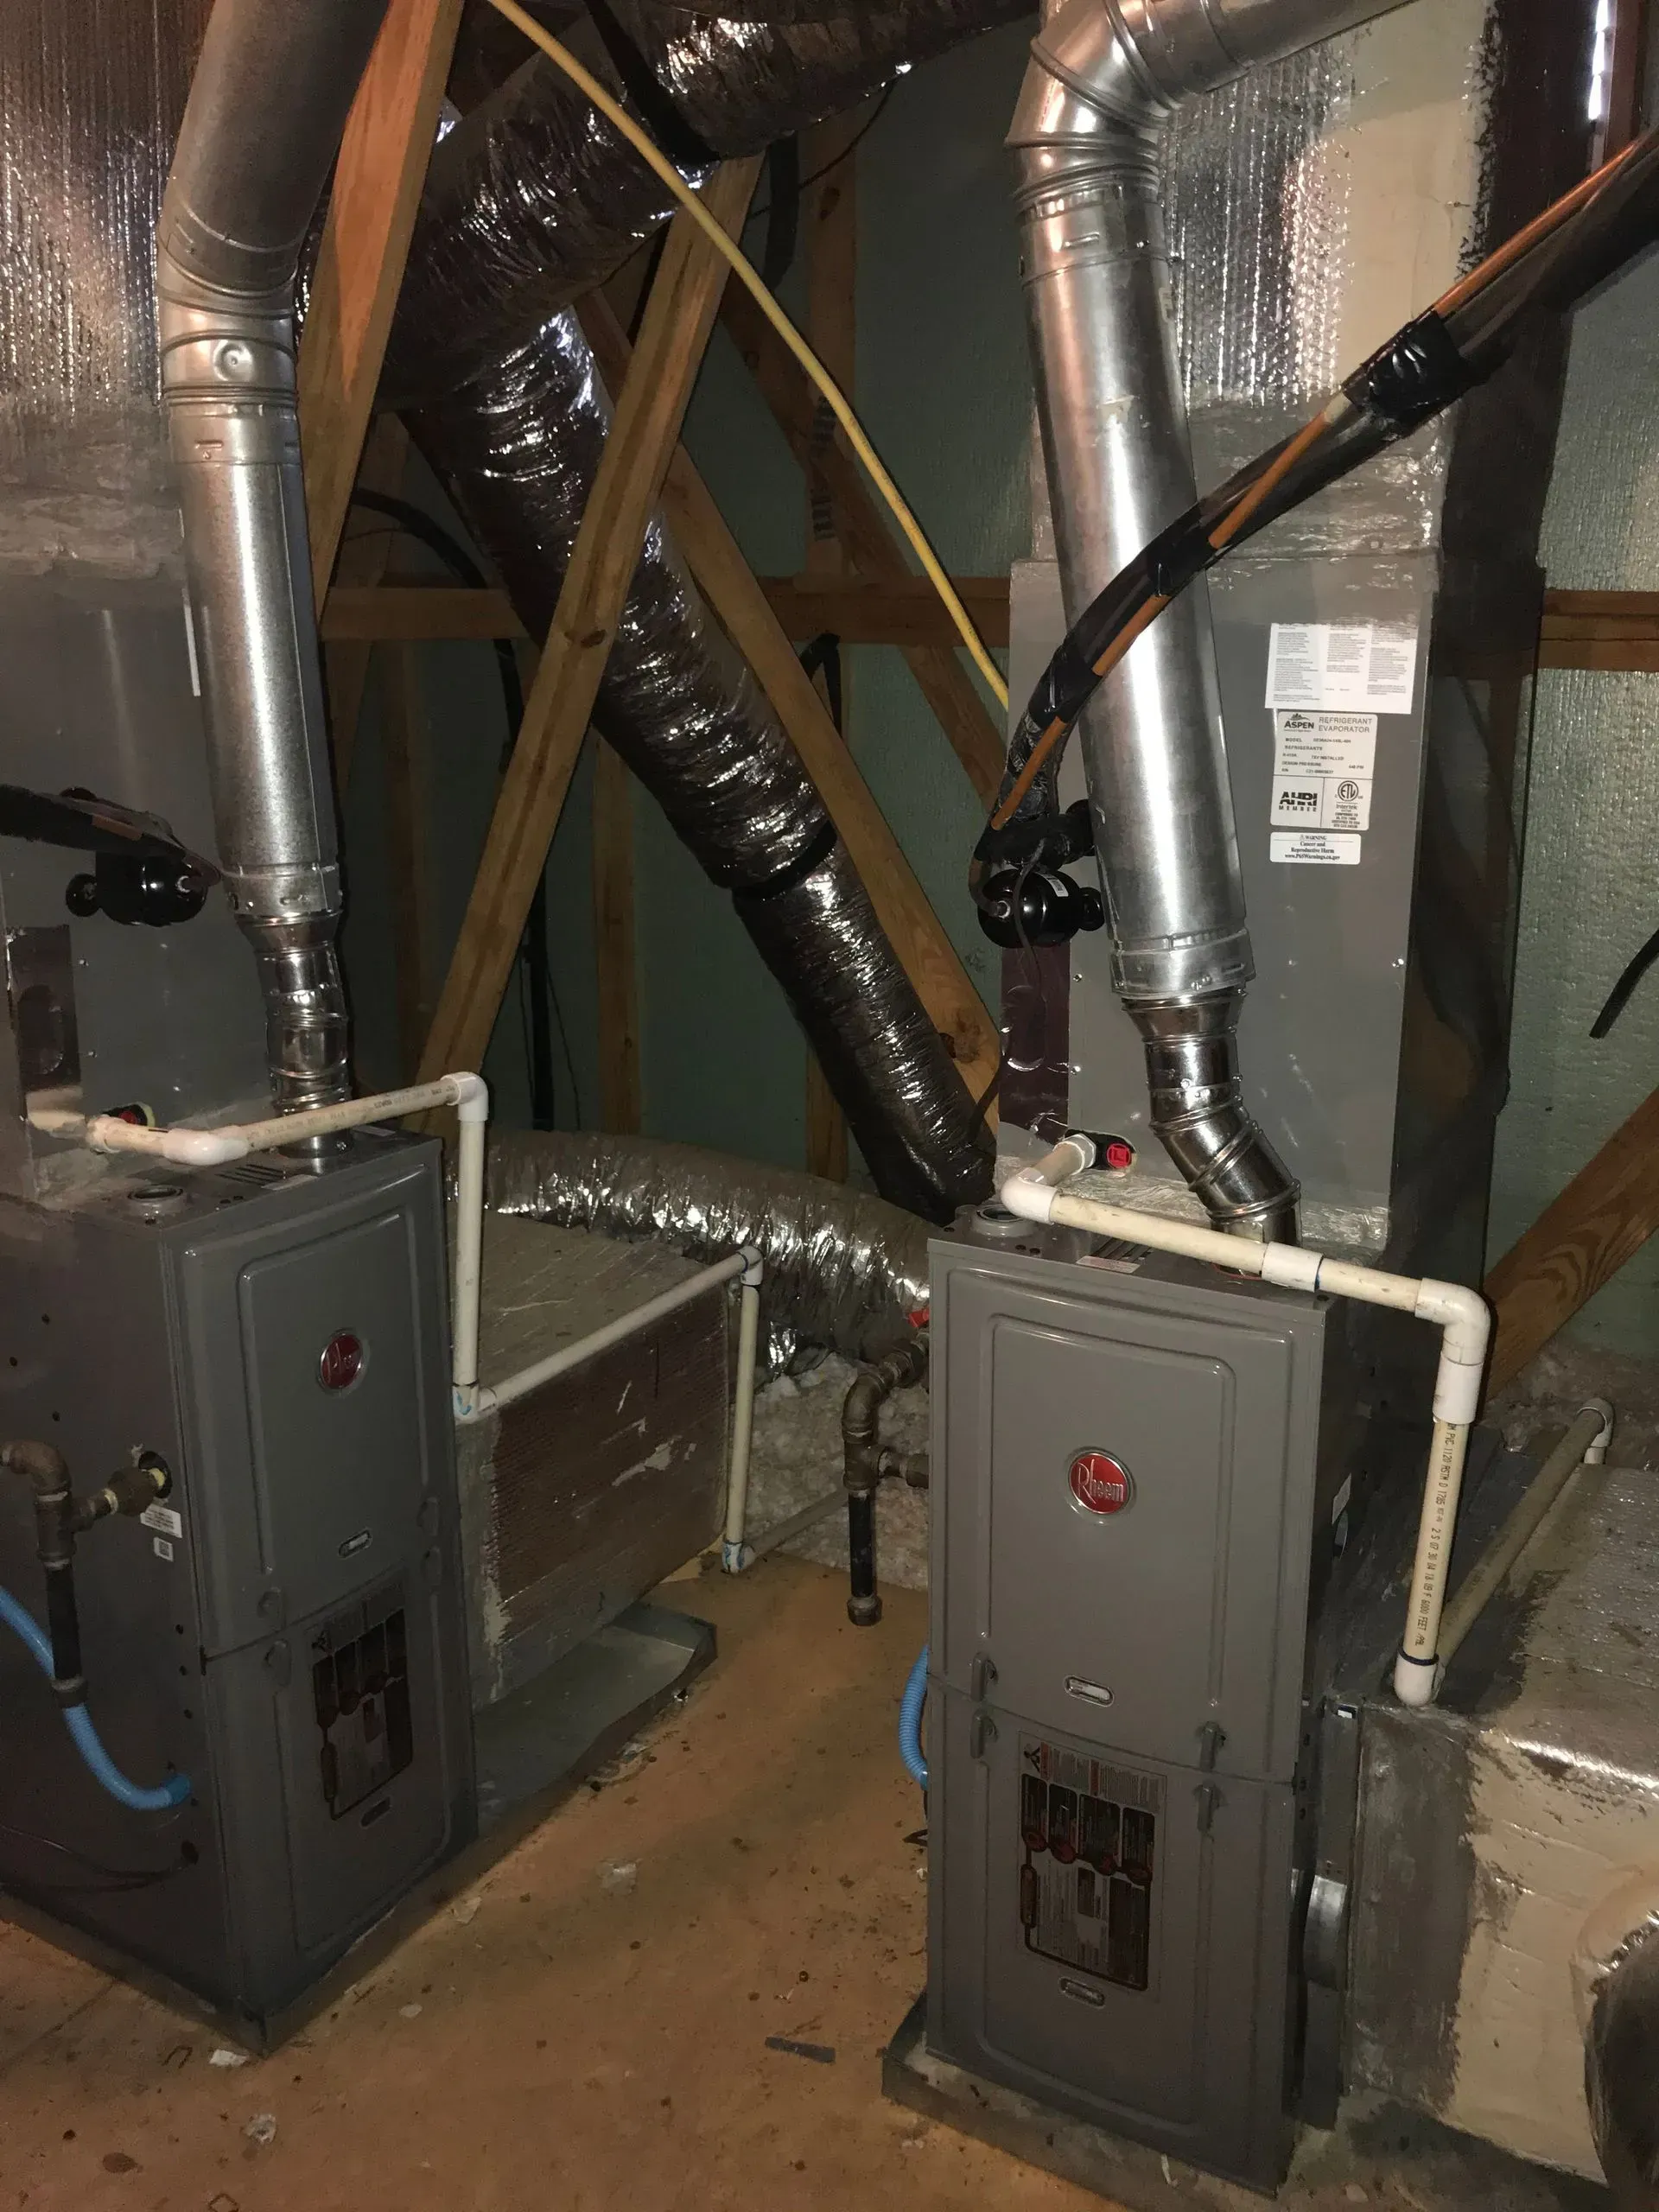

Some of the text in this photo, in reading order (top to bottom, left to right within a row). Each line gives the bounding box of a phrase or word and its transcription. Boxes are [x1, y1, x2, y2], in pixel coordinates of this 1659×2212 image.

[1284, 721, 1314, 729] ASPEN
[1319, 716, 1372, 725] REFRIGERANT
[1279, 791, 1319, 806] AHRI
[1445, 1433, 1455, 1445] PVC
[1443, 1448, 1453, 1463] 1120
[1440, 1465, 1451, 1480] ASTM
[1077, 1459, 1123, 1503] Rheem
[1436, 1491, 1447, 1505] 1785
[1417, 1616, 1428, 1631] FEET
